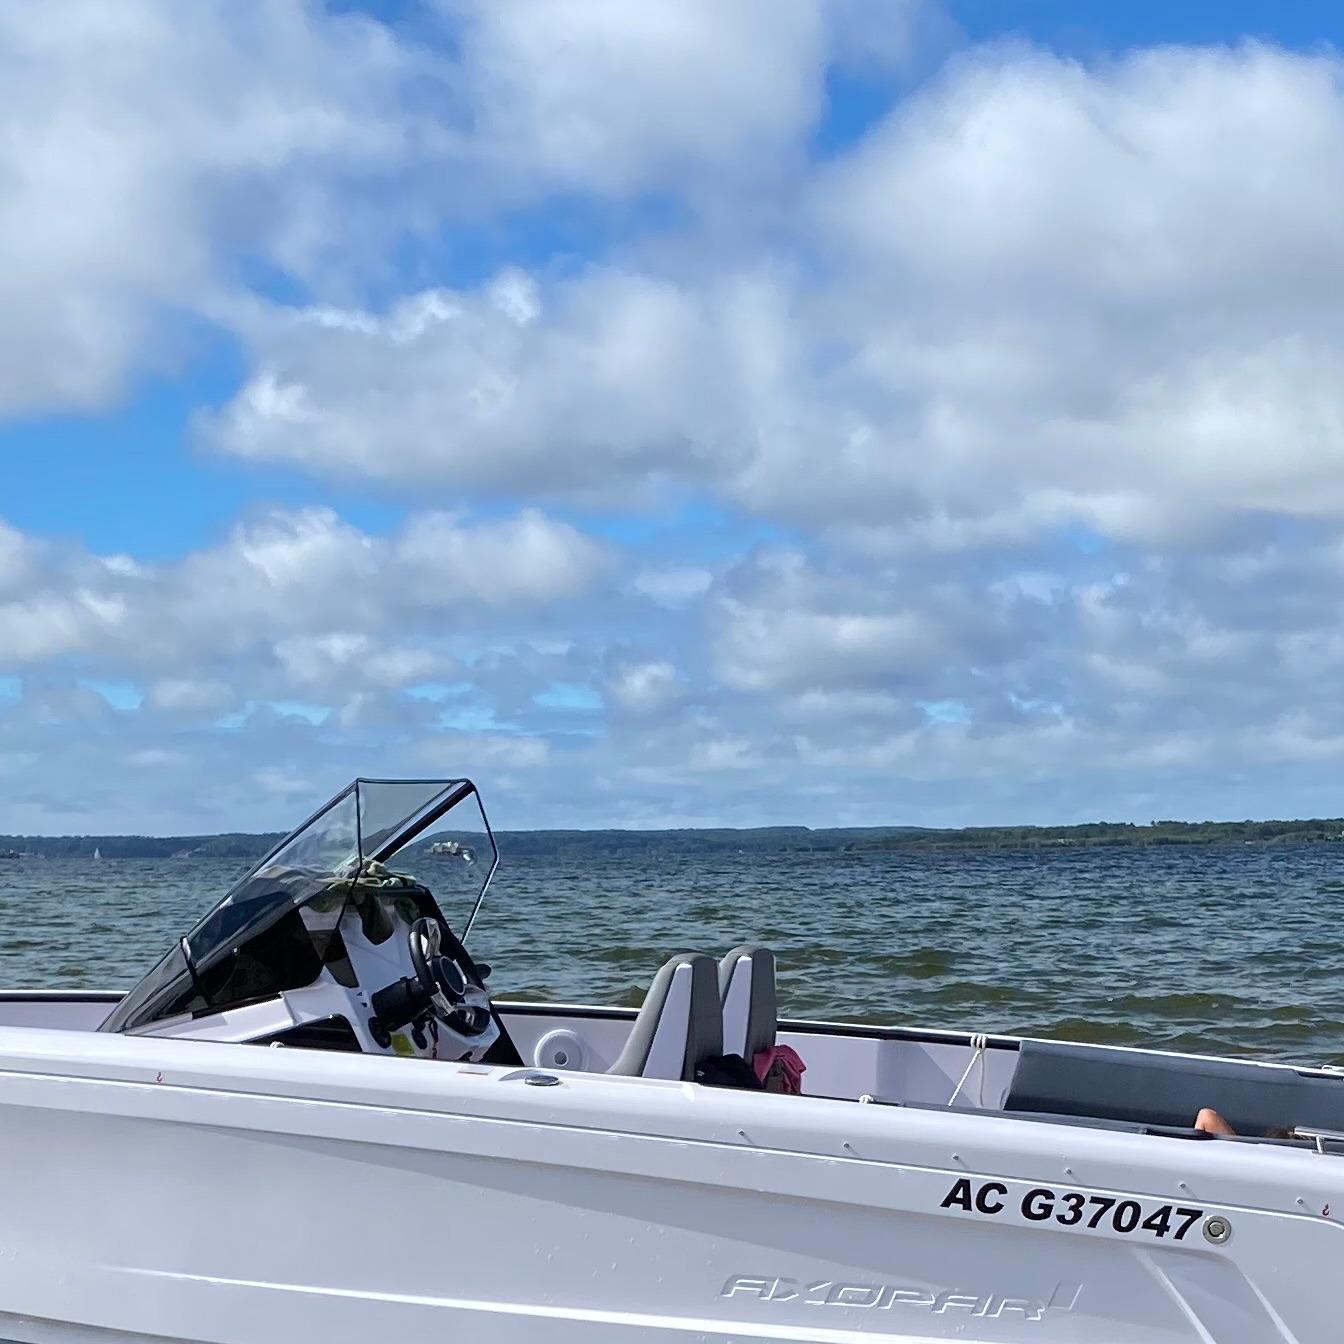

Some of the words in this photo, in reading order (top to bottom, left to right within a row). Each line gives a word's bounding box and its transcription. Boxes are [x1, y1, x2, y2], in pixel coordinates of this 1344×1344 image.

[940, 1178, 1008, 1214] AC
[1020, 1188, 1203, 1241] G37047
[720, 1274, 1046, 1320] AXOPAR
